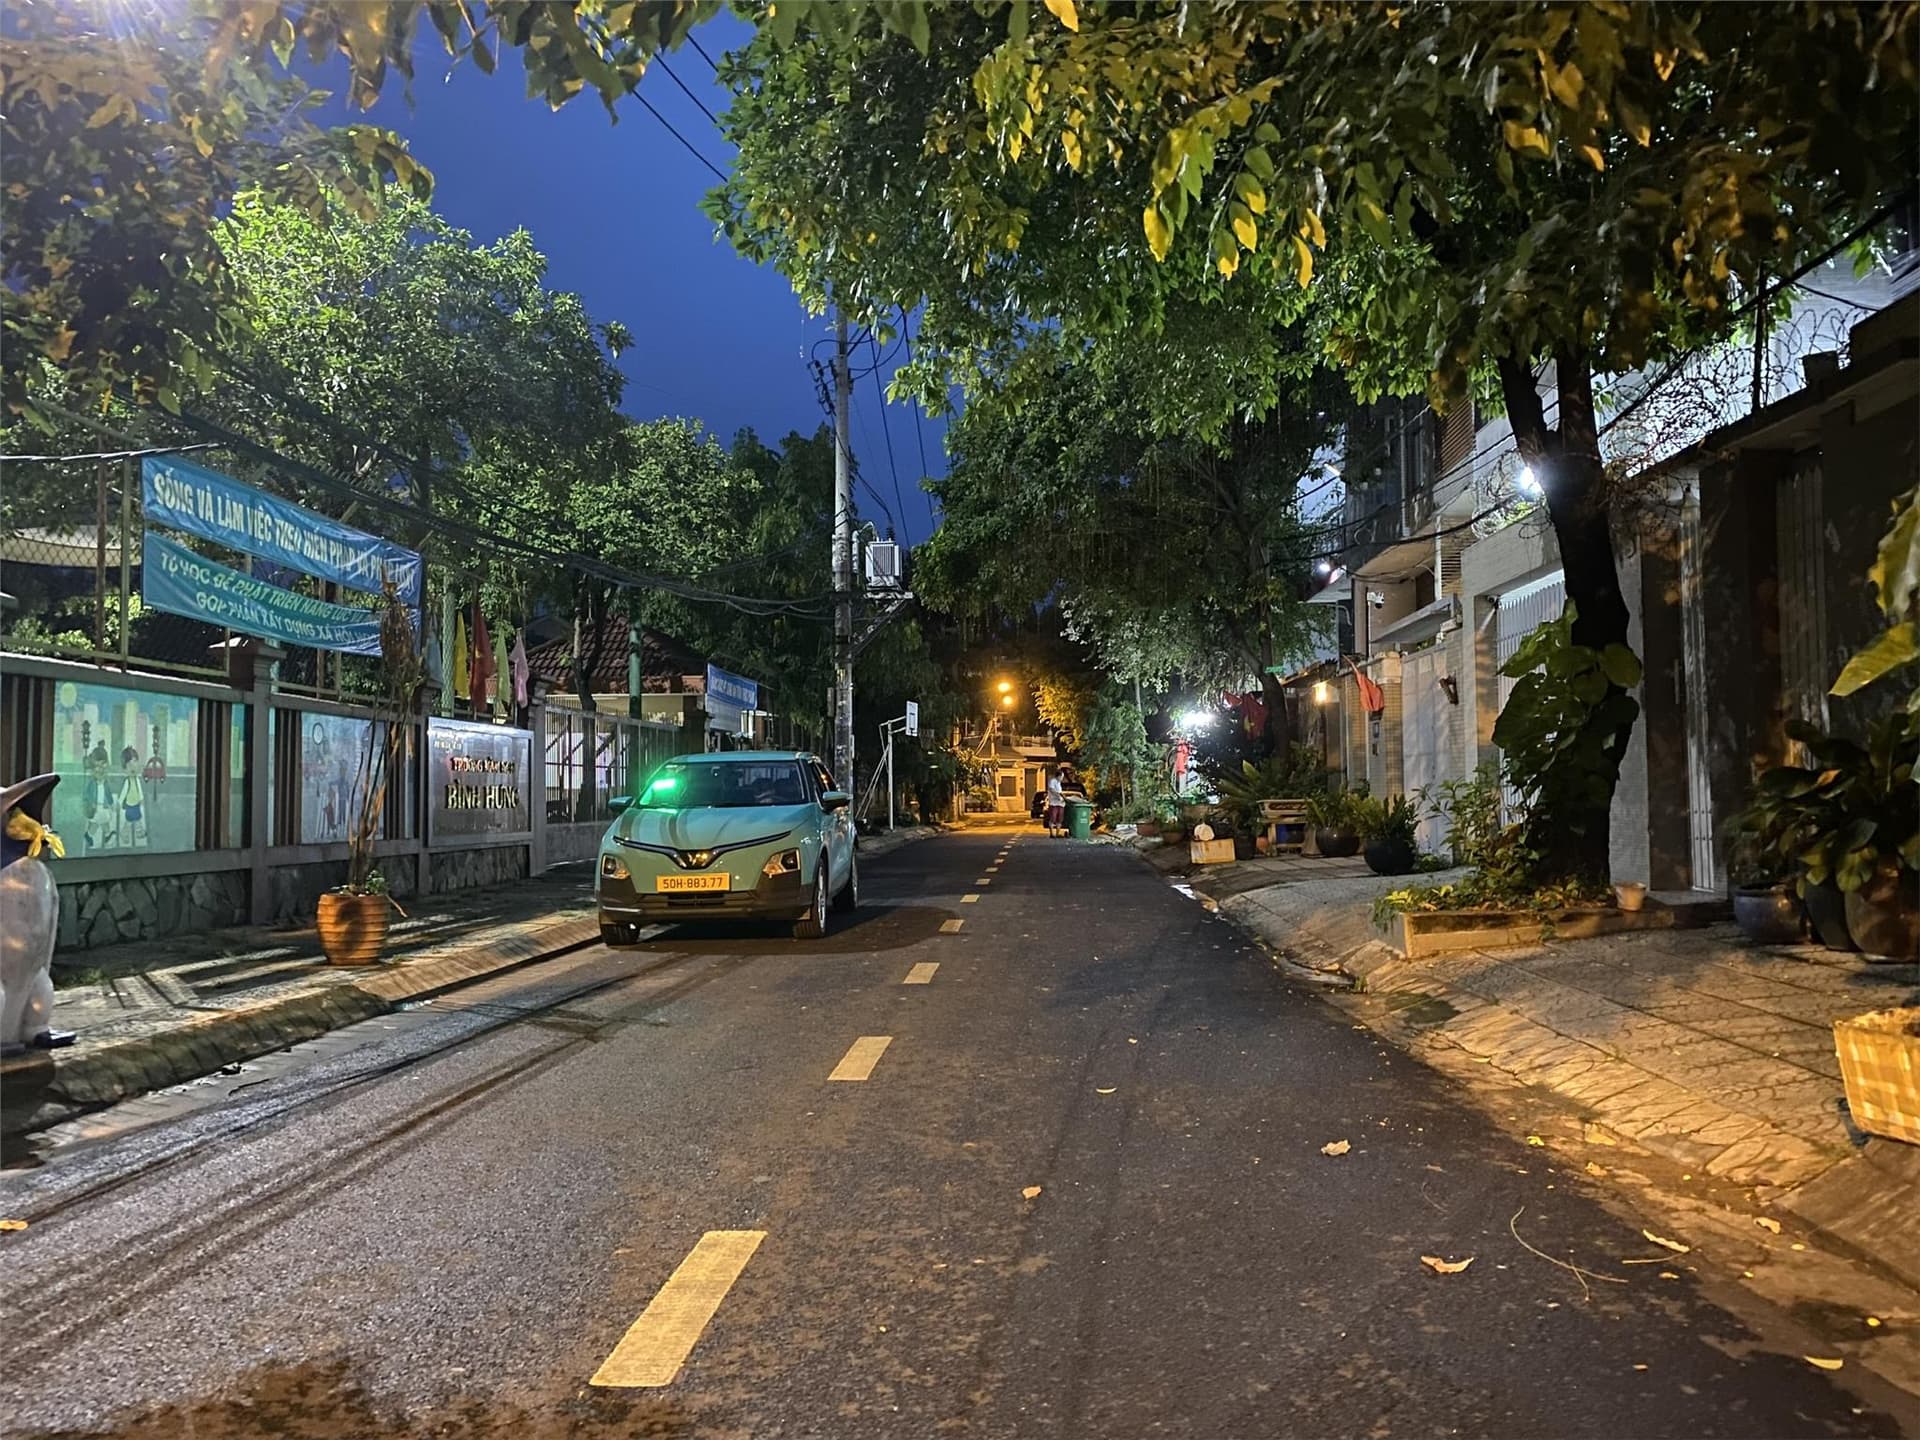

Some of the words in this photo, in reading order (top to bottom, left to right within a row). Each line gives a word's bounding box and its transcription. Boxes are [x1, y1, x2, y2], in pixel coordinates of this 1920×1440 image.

[153, 467, 194, 514] SỐNG
[196, 485, 215, 523] VÀ
[217, 493, 245, 533] LÀM
[246, 504, 272, 546] VIỆC
[274, 518, 302, 554] THEO
[231, 582, 271, 600] PHÁT
[283, 617, 316, 639] DỰNG
[446, 780, 482, 809] BÌNH
[662, 877, 723, 889] 50H-883.77
